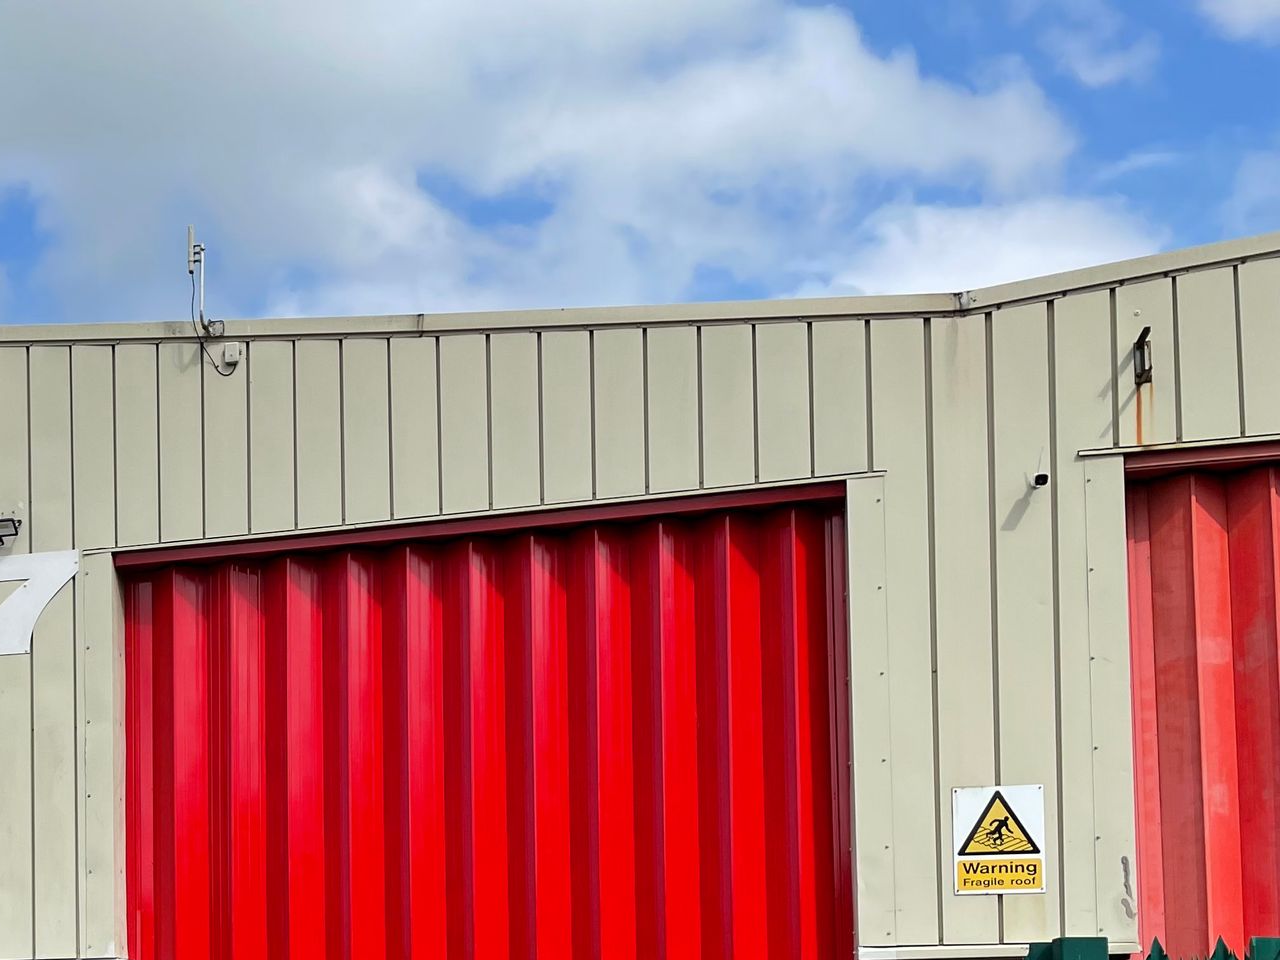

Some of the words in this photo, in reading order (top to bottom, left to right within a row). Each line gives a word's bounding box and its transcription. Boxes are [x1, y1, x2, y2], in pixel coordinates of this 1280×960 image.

[963, 861, 1037, 875] Warning
[963, 877, 1005, 888] Fragile
[1010, 876, 1036, 886] roof
